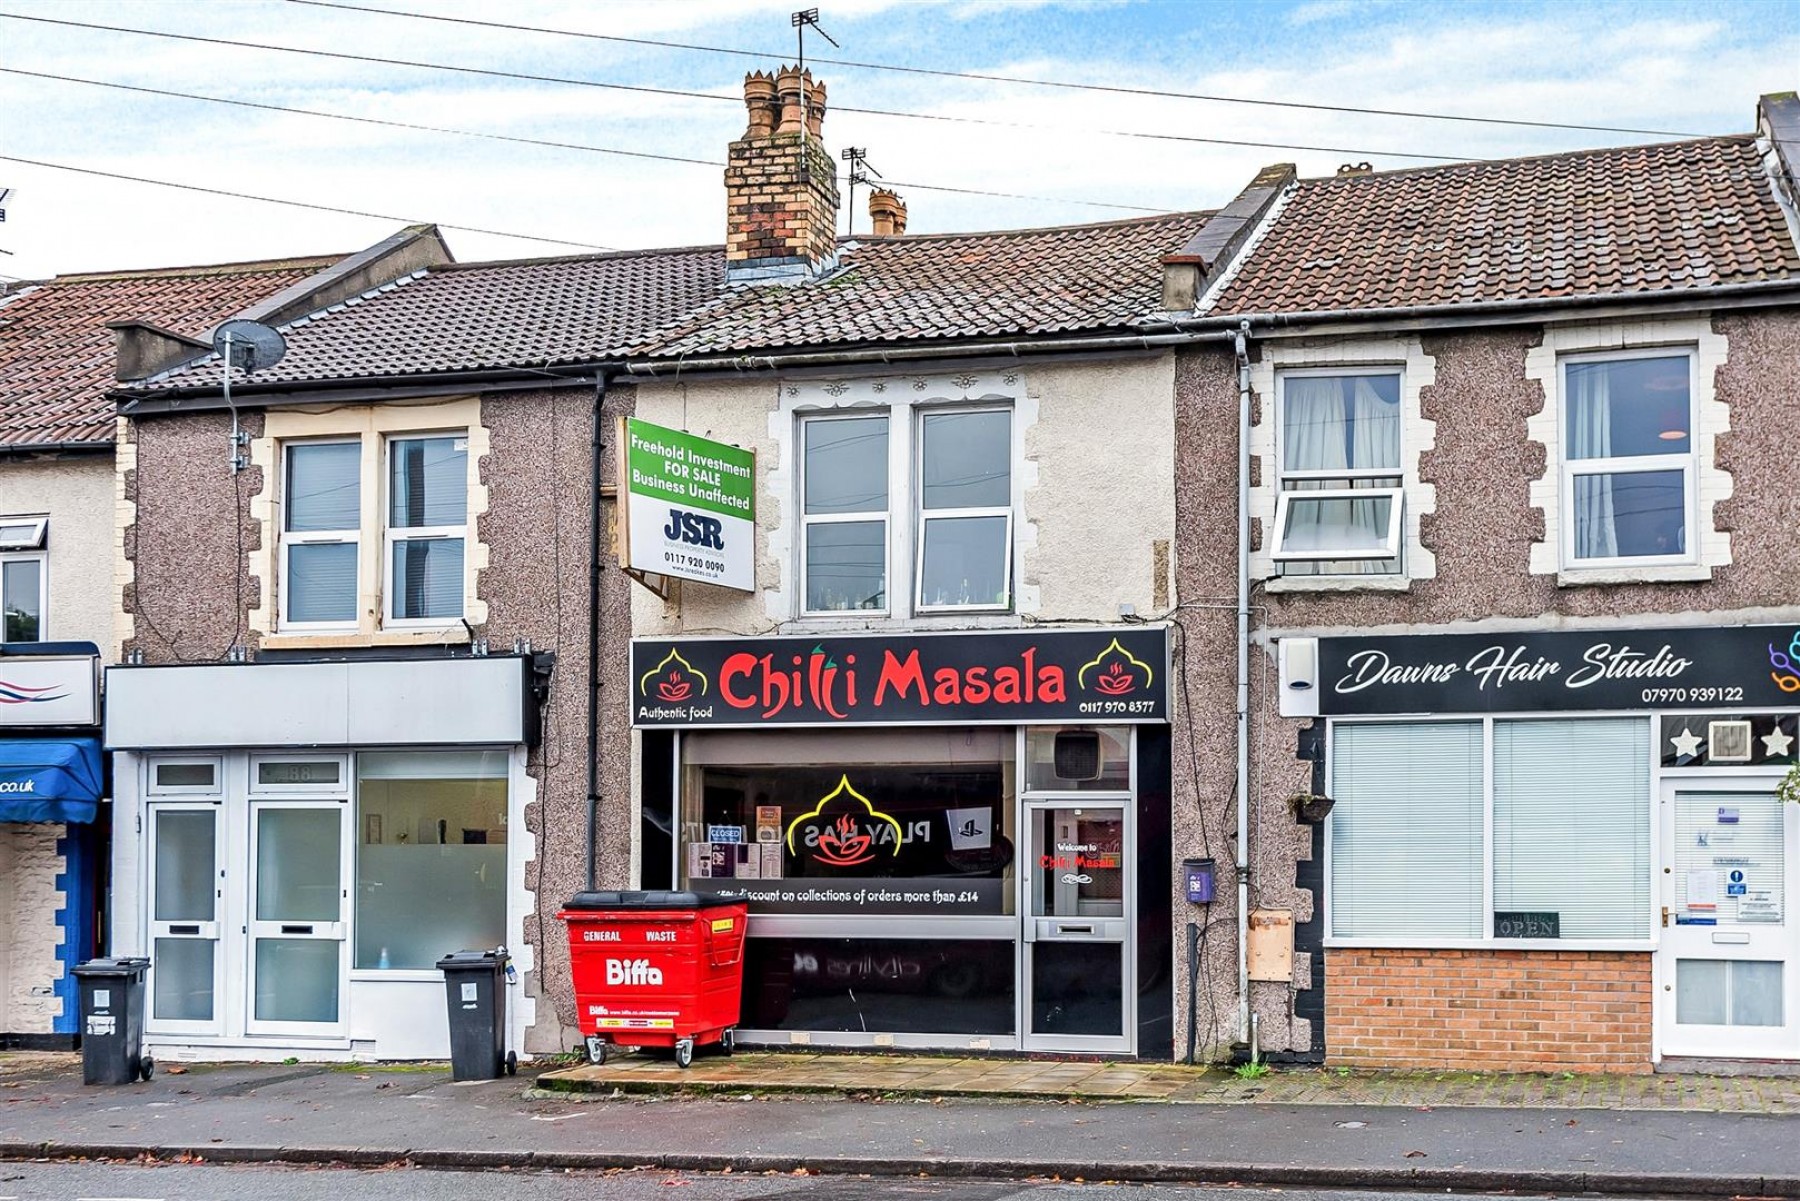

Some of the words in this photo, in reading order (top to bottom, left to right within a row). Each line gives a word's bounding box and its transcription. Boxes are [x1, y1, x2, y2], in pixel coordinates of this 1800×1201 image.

[631, 434, 684, 460] Freehold
[688, 449, 751, 479] Investment
[664, 460, 690, 479] FOR
[692, 468, 721, 487] SALE
[632, 468, 685, 495] Business
[689, 482, 750, 511] Unaffected
[663, 508, 725, 551] JSR
[664, 551, 686, 565] 0117
[688, 556, 703, 568] 920
[705, 559, 725, 573] 0090
[1334, 650, 1460, 694] Dawns
[1465, 645, 1561, 691] Hair
[1565, 643, 1693, 688] Studio
[719, 642, 858, 719] Chilli
[873, 647, 1067, 707] Masala
[1641, 688, 1687, 702] 07970
[1689, 687, 1743, 702] 939122
[638, 705, 687, 720] Authentic
[689, 705, 713, 721] food
[1079, 702, 1103, 713] 0117
[1105, 701, 1127, 714] 970
[1128, 700, 1155, 713] 8377
[711, 829, 740, 837] CLOSED
[1057, 843, 1088, 852] Welcome
[1089, 843, 1097, 851] to
[1074, 856, 1116, 868] Masala
[782, 891, 795, 902] on
[797, 888, 851, 902] collections
[853, 888, 866, 905] of
[867, 889, 902, 902] orders
[904, 891, 930, 903] more
[932, 889, 956, 904] than
[958, 891, 979, 903] £14
[584, 930, 621, 942] GENERAL
[646, 930, 677, 942] WASTE
[1500, 921, 1554, 935] OPEN
[606, 958, 663, 985] Biffa
[589, 1005, 608, 1015] Biffa
